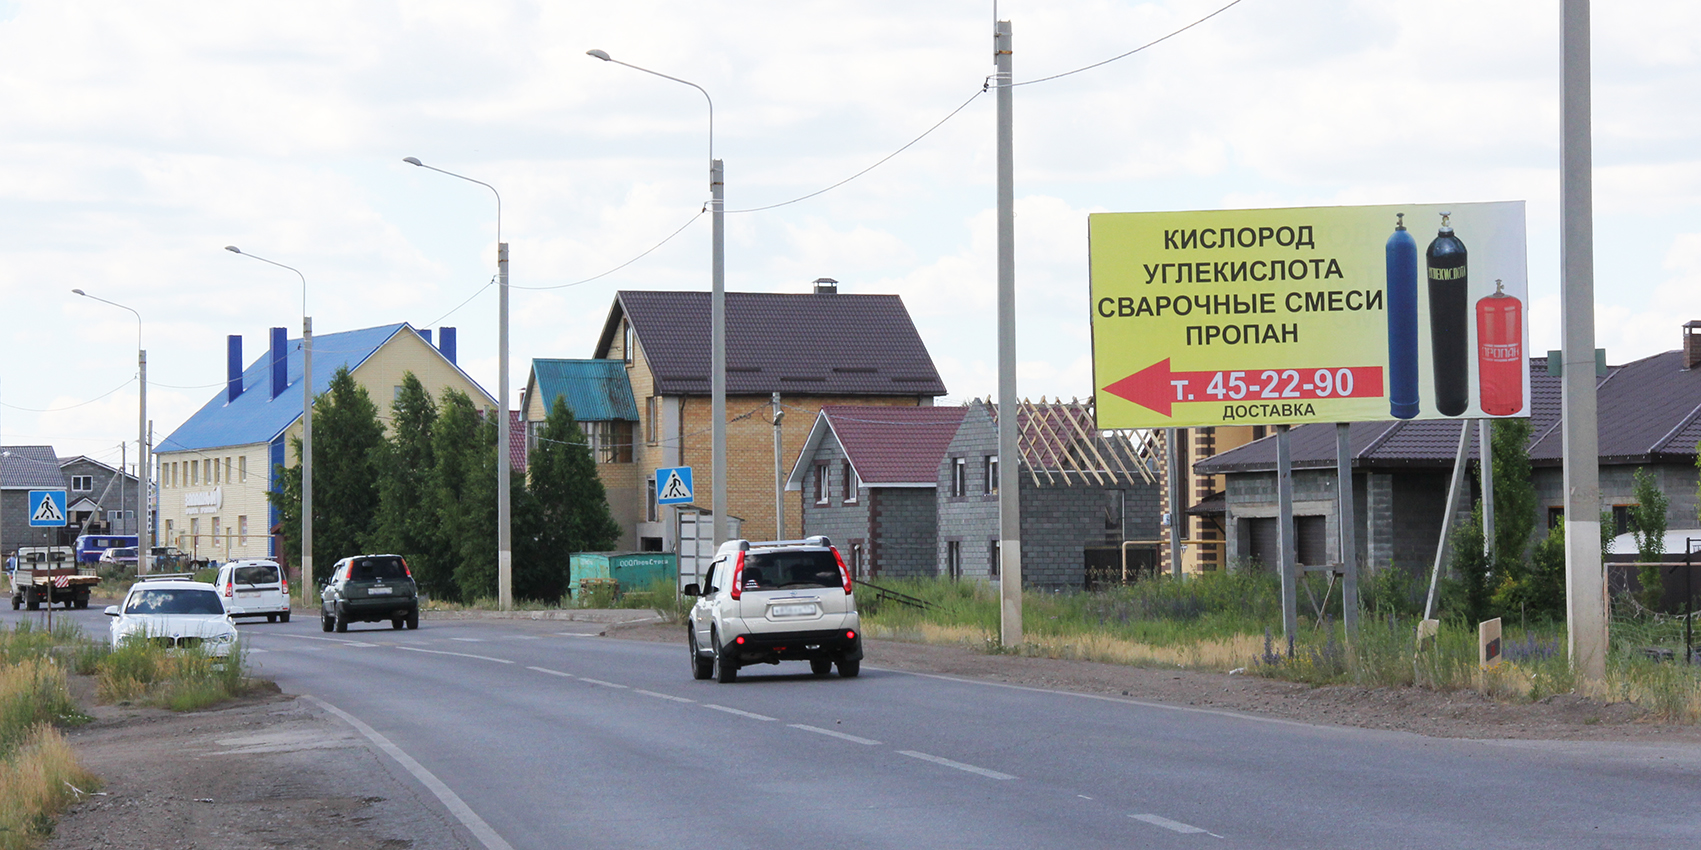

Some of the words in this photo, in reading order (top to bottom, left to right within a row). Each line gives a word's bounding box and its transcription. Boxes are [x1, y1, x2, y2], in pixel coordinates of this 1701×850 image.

[1164, 225, 1315, 250] КИСЛОРОД
[1143, 258, 1344, 284] УГЛЕКИСЛОТА
[1098, 292, 1276, 318] СВАРОЧНЫЕ
[1285, 289, 1383, 313] СМЕСИ
[1186, 323, 1298, 346] ПРОПАН
[1481, 346, 1520, 358] ПРОПАН
[1171, 379, 1194, 401] т.
[1206, 367, 1355, 401] 45-22-90
[1222, 403, 1316, 421] ДОСТАВКА
